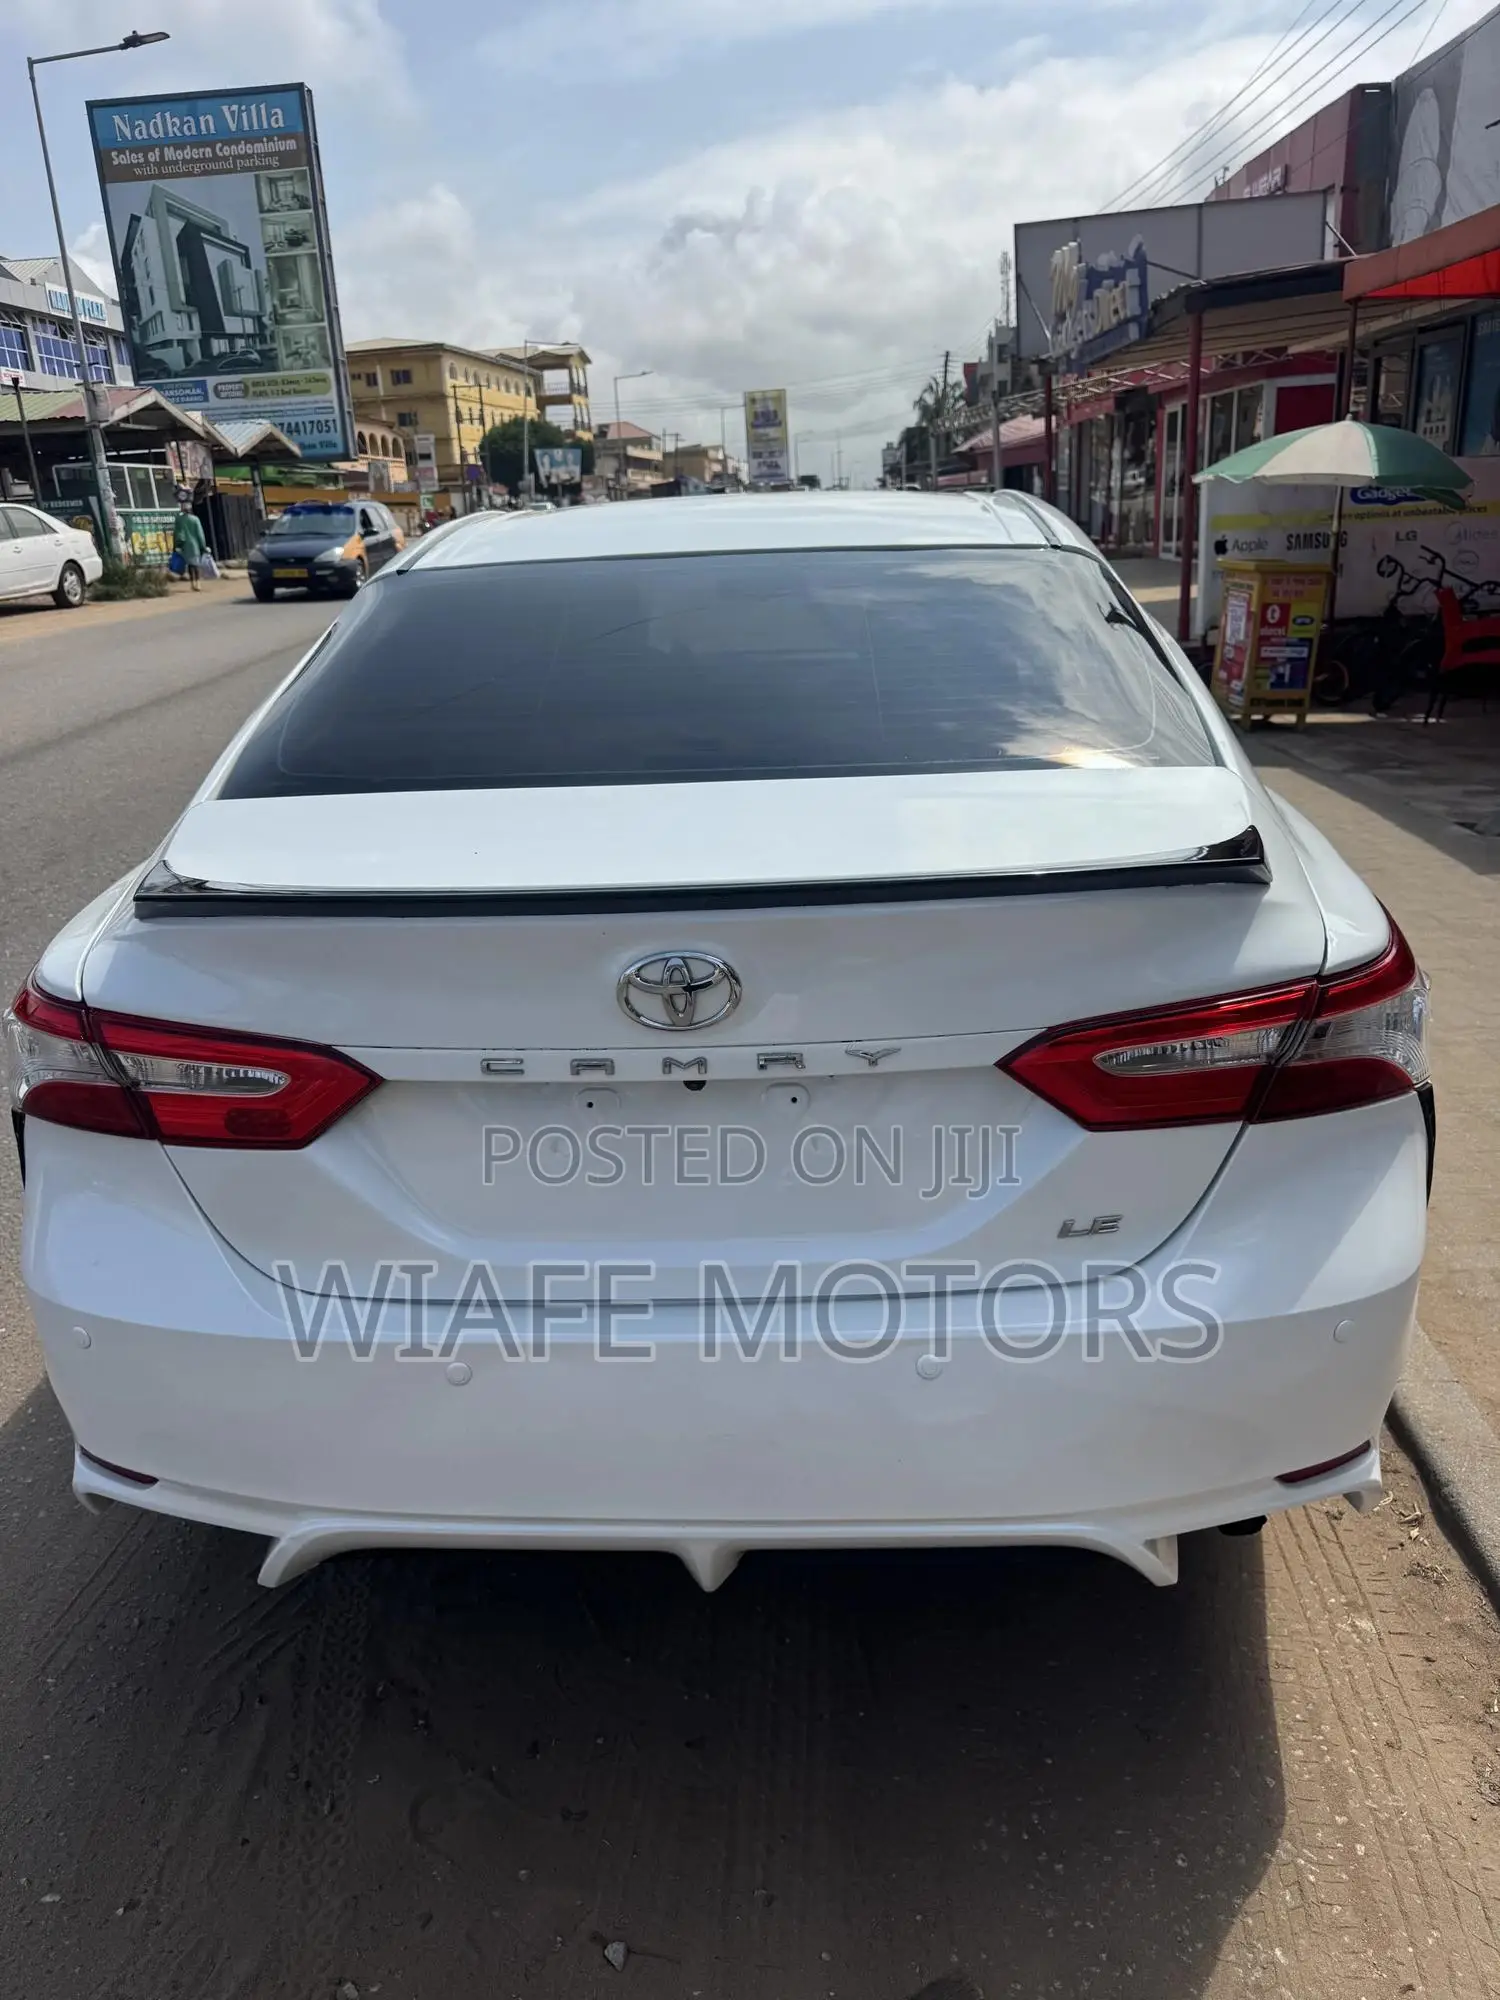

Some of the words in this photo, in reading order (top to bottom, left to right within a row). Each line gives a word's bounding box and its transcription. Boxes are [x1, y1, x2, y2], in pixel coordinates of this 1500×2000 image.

[112, 111, 216, 142] Nadkan
[221, 103, 284, 132] Villa
[111, 149, 144, 166] Sales
[148, 147, 161, 164] of
[164, 145, 212, 161] Modern
[216, 137, 297, 155] Condominium
[133, 162, 159, 177] with
[162, 156, 234, 175] underground
[236, 154, 280, 170] parking
[274, 418, 337, 436] 74417051
[1286, 531, 1348, 551] SAMSUG
[1395, 530, 1418, 541] LG
[480, 1045, 901, 1076] CAMRY
[1057, 1214, 1124, 1239] LE
